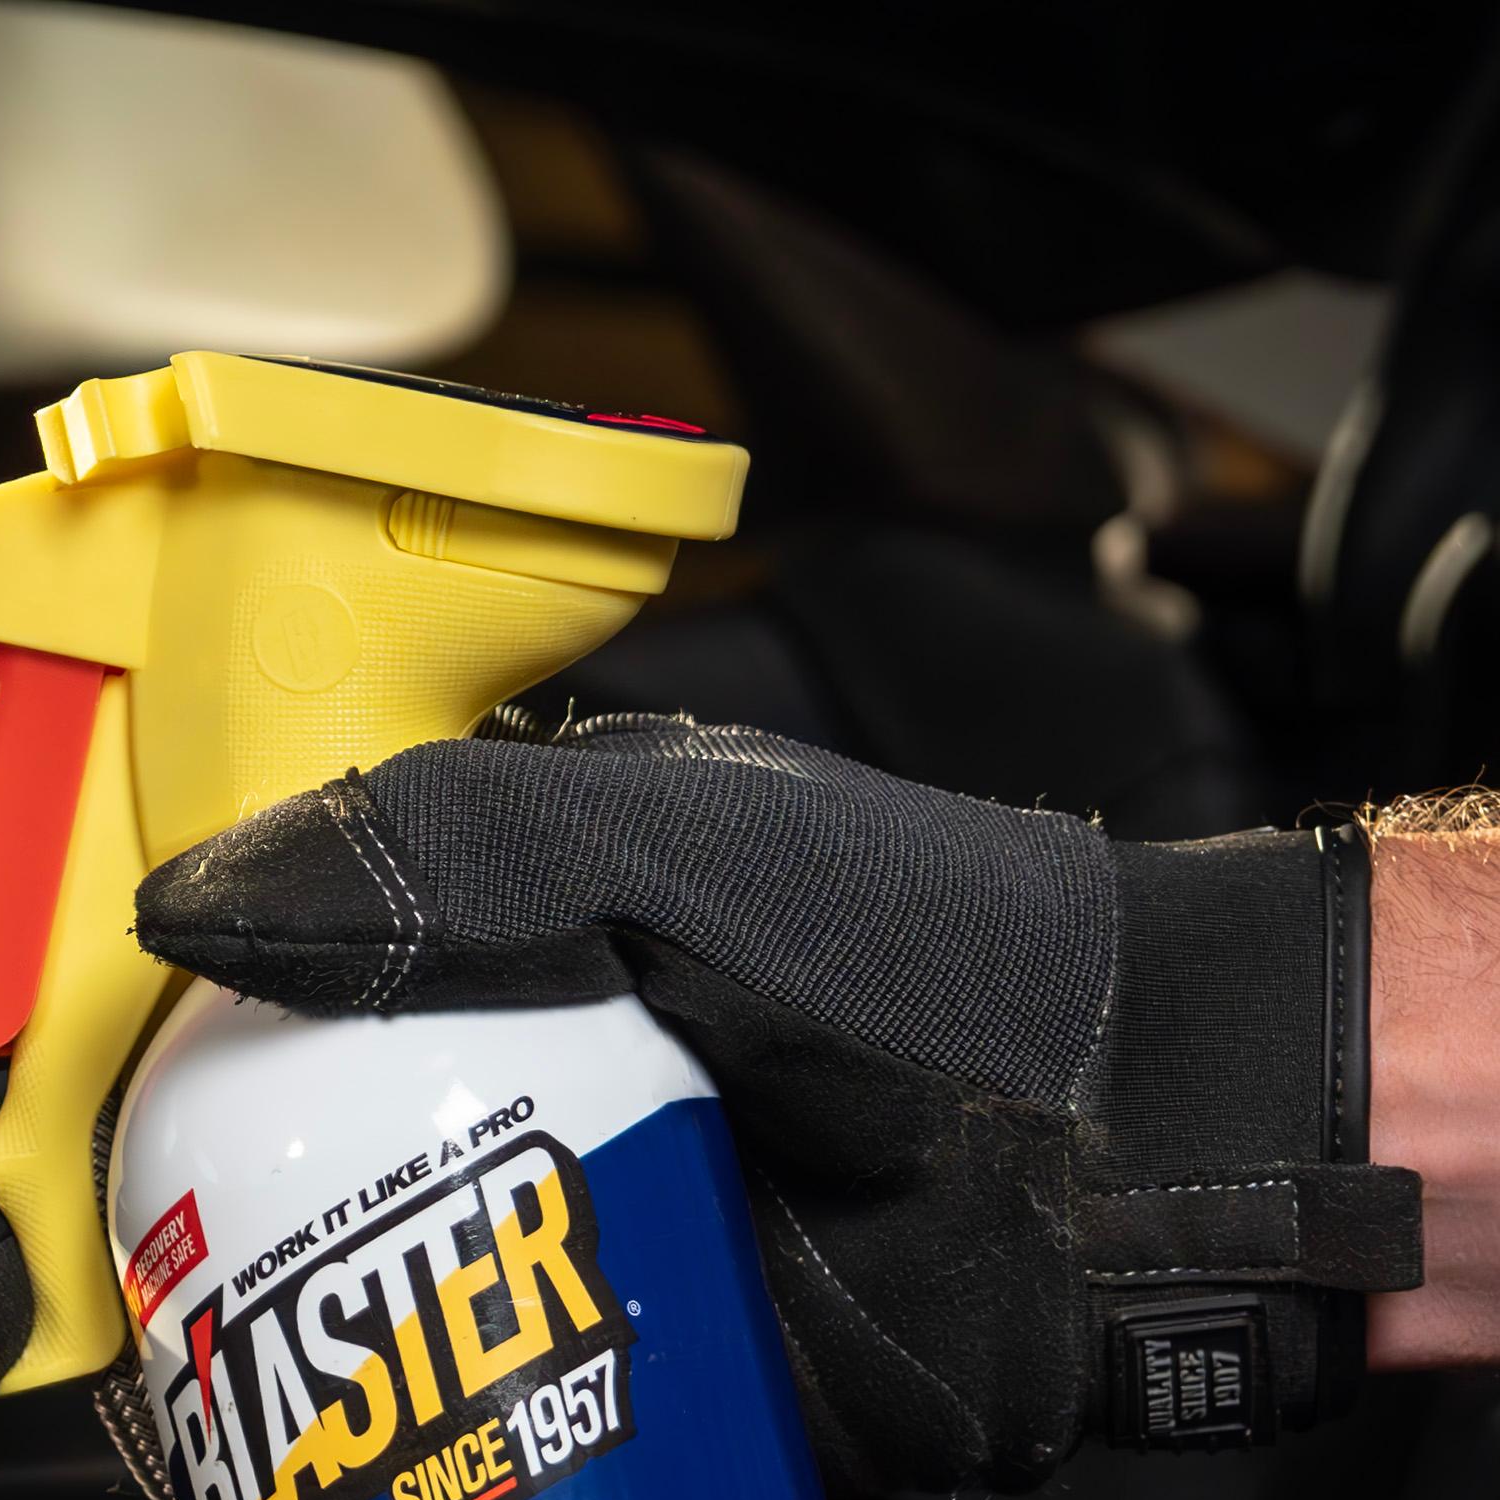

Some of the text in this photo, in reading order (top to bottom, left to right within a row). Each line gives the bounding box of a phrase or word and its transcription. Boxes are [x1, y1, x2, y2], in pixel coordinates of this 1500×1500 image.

[231, 1095, 535, 1298] WORK IT LIKE A PRO
[135, 1211, 186, 1283] RECOVERY
[140, 1233, 196, 1310] MACHINE SAFE
[506, 1348, 622, 1478] 1957
[1179, 1349, 1207, 1420] SINCE
